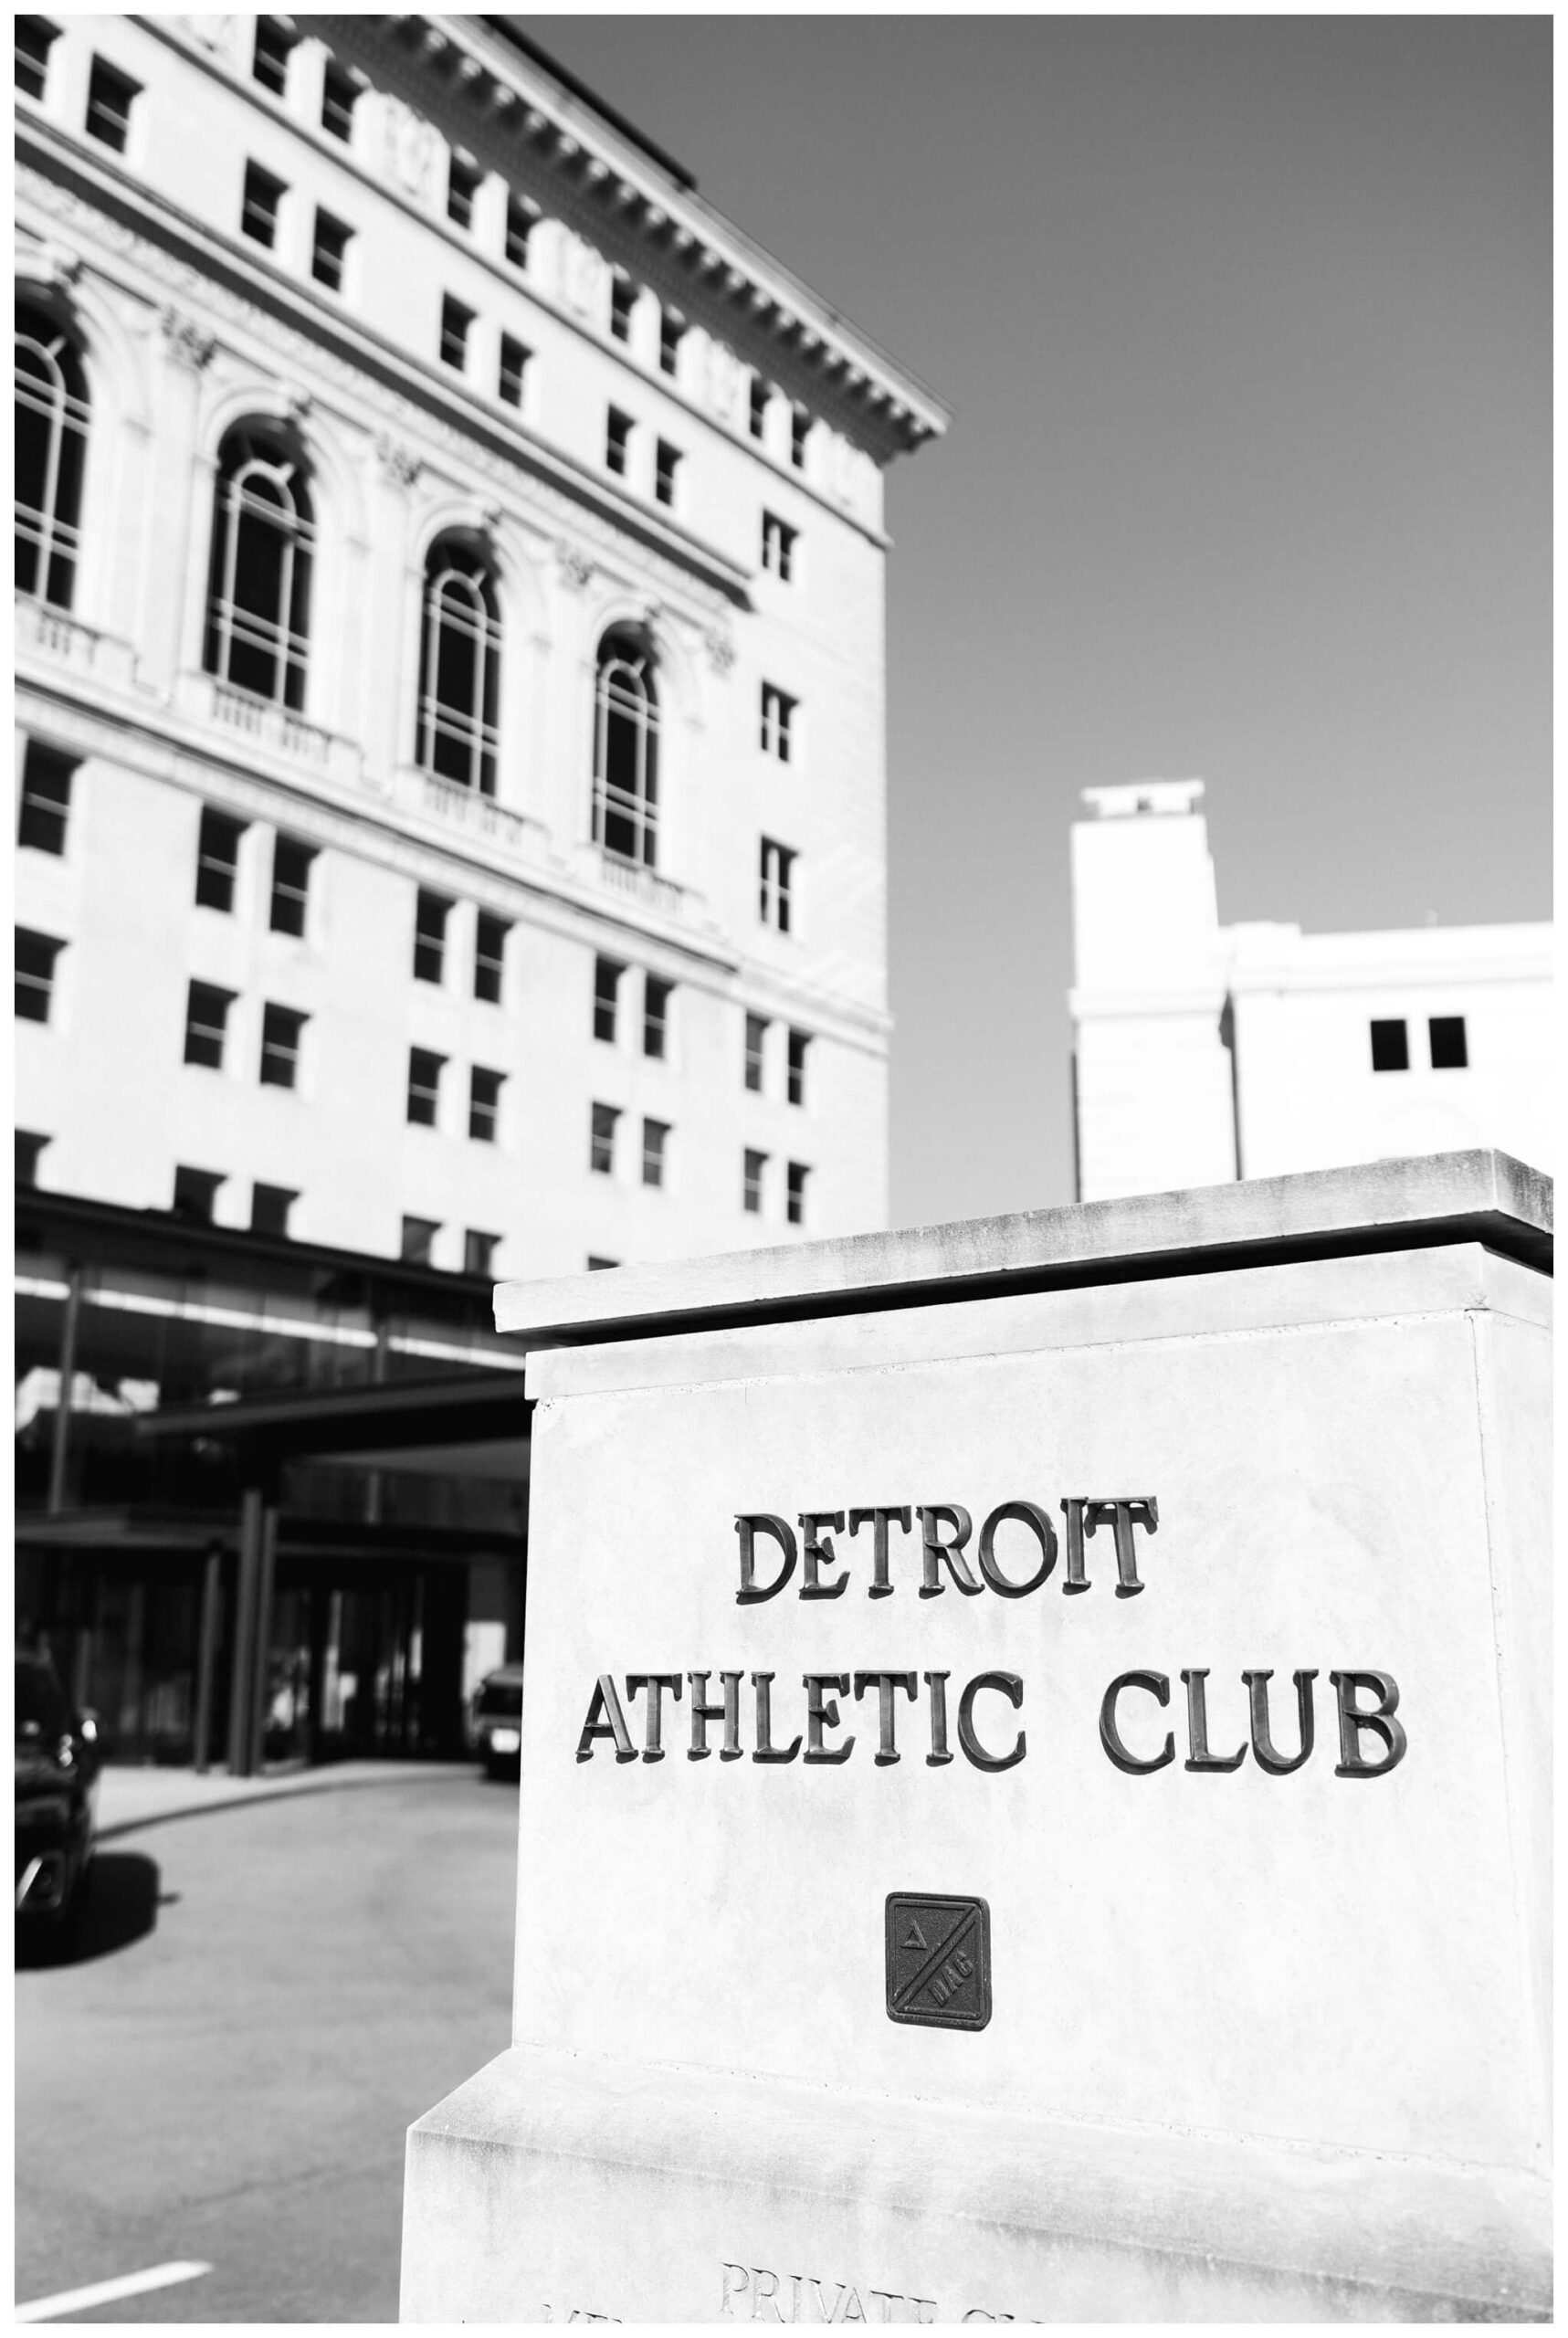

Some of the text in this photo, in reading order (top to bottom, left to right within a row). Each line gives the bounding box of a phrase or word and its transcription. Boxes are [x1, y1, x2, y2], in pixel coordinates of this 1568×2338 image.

[734, 1496, 1158, 1605] DETROIT
[575, 1668, 1407, 1779] ATHLETIC CLUB
[927, 1950, 973, 2007] DAC
